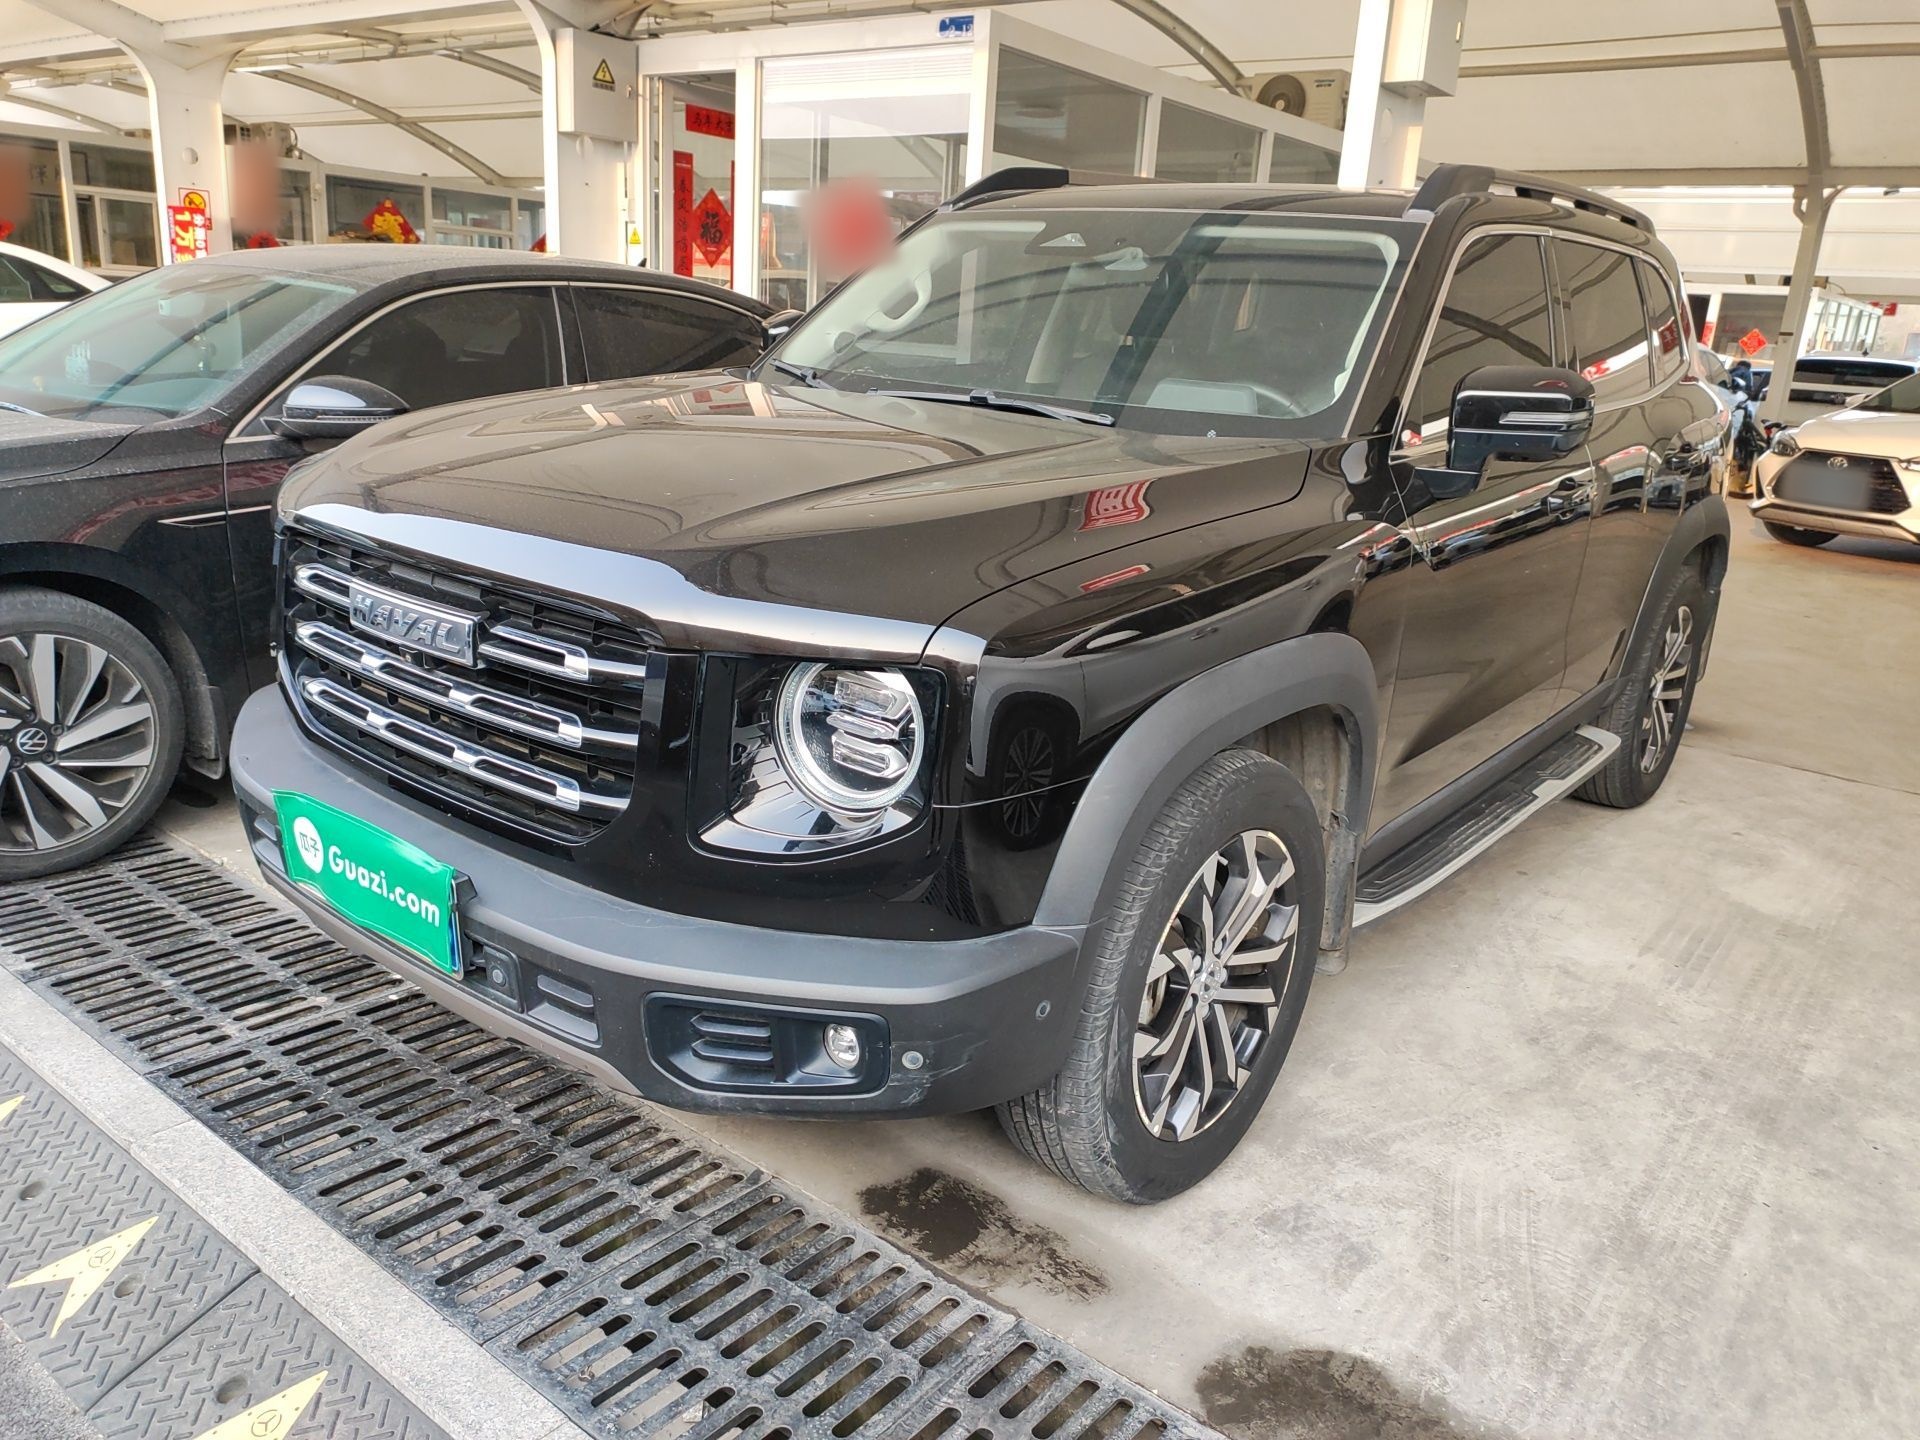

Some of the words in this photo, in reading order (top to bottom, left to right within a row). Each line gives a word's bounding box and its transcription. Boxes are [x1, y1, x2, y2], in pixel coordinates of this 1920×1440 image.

[700, 210, 723, 245] 福
[353, 594, 461, 654] HAVAL
[298, 831, 321, 858] 瓜子
[328, 845, 441, 928] Guazi.com
